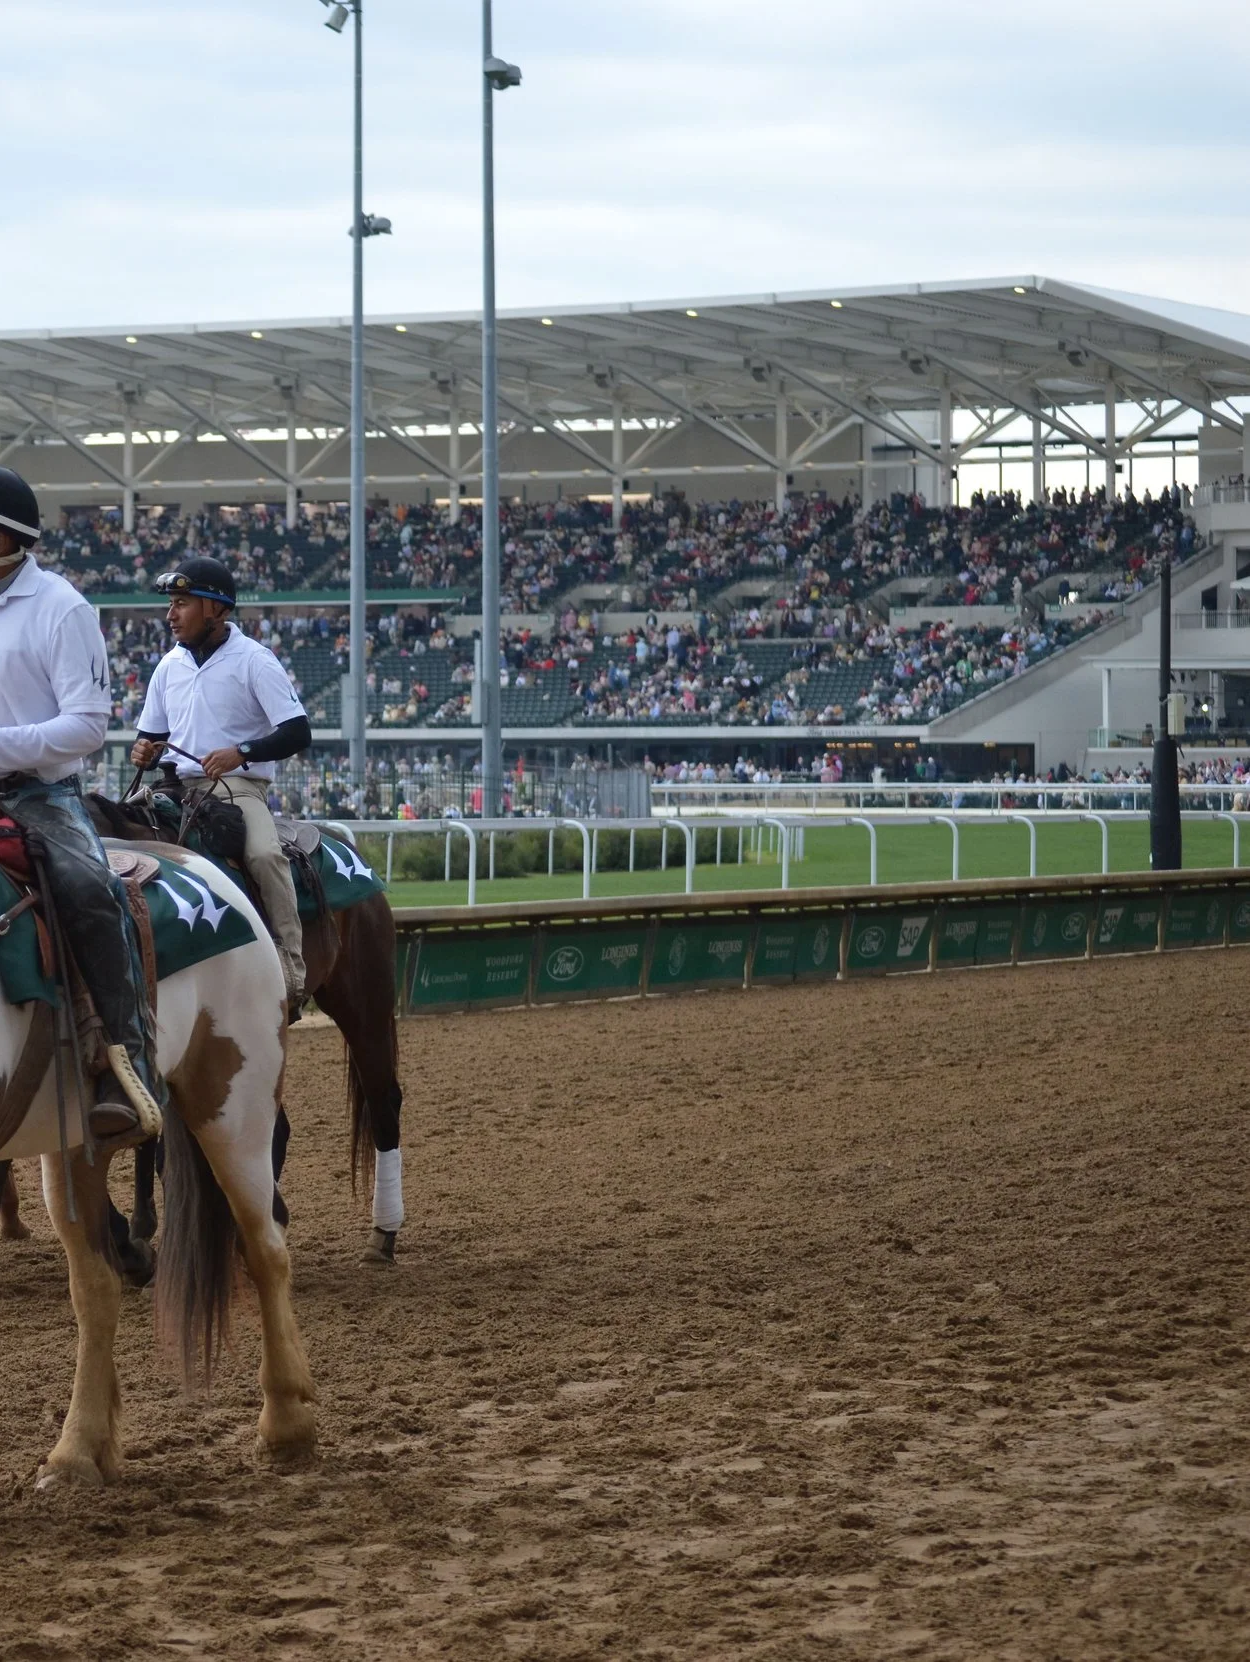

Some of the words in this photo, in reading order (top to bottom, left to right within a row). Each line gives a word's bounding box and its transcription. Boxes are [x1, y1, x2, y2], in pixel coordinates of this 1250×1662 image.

[900, 926, 920, 947] SAP
[601, 943, 639, 961] LONGINES
[553, 951, 578, 975] Ford
[486, 968, 520, 982] RESERVE
